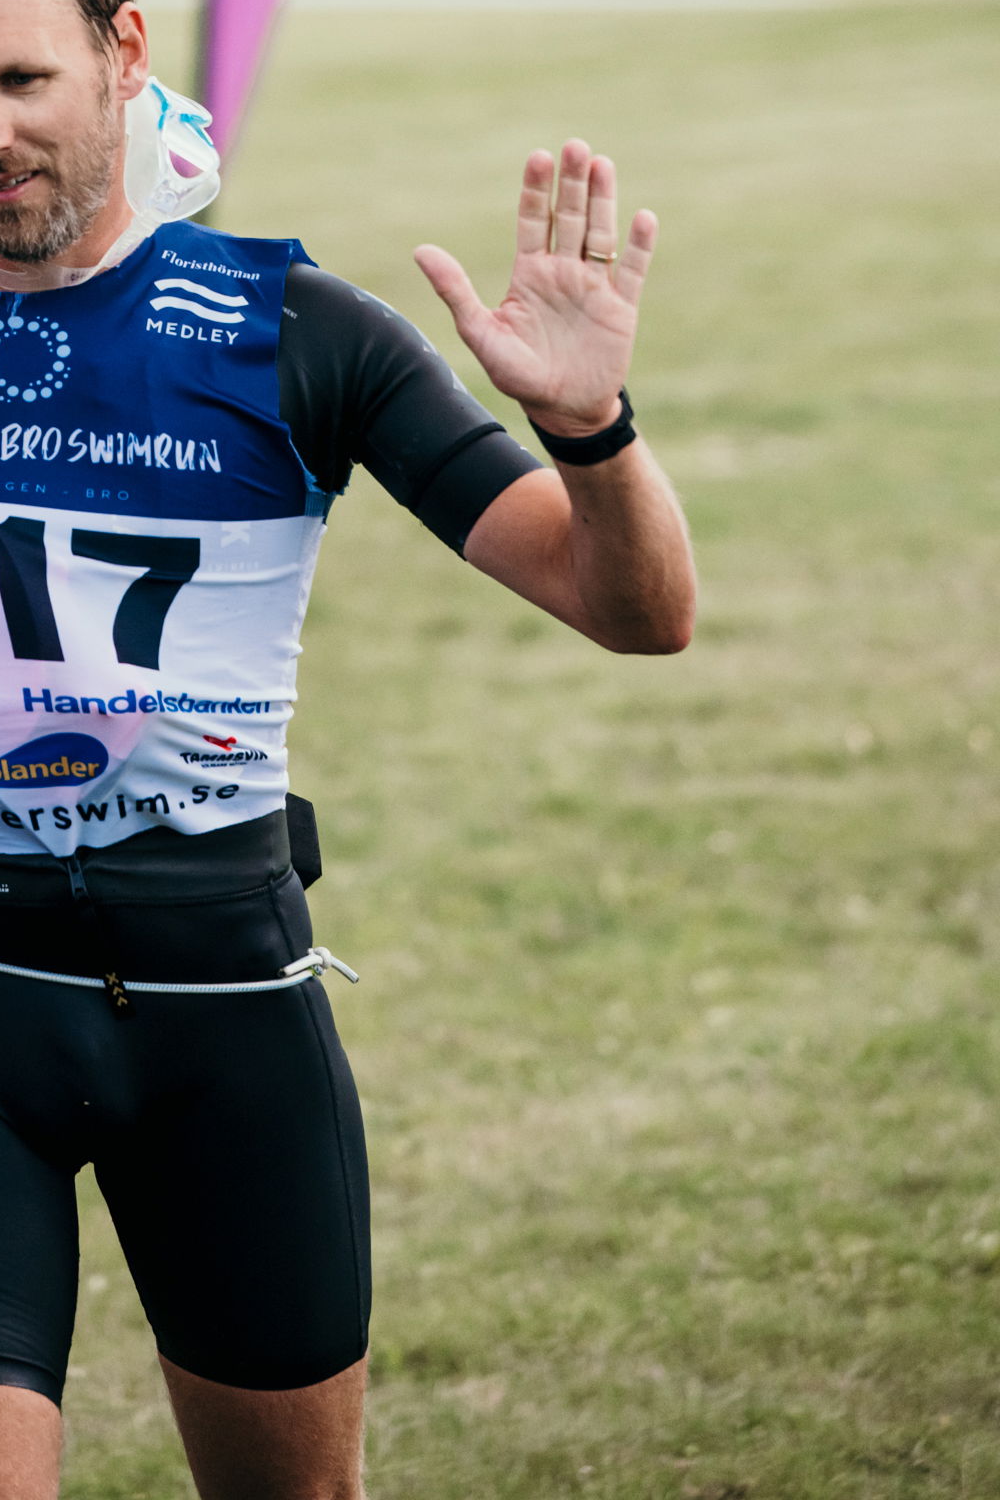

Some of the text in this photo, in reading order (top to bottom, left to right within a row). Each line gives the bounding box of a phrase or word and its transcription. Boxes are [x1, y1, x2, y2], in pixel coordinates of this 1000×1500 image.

[161, 249, 261, 281] Floristhörnan
[145, 318, 240, 345] MEDLEY
[67, 428, 222, 473] SWIMRUN
[86, 488, 130, 501] BRO
[22, 686, 271, 716] Handelsbanken
